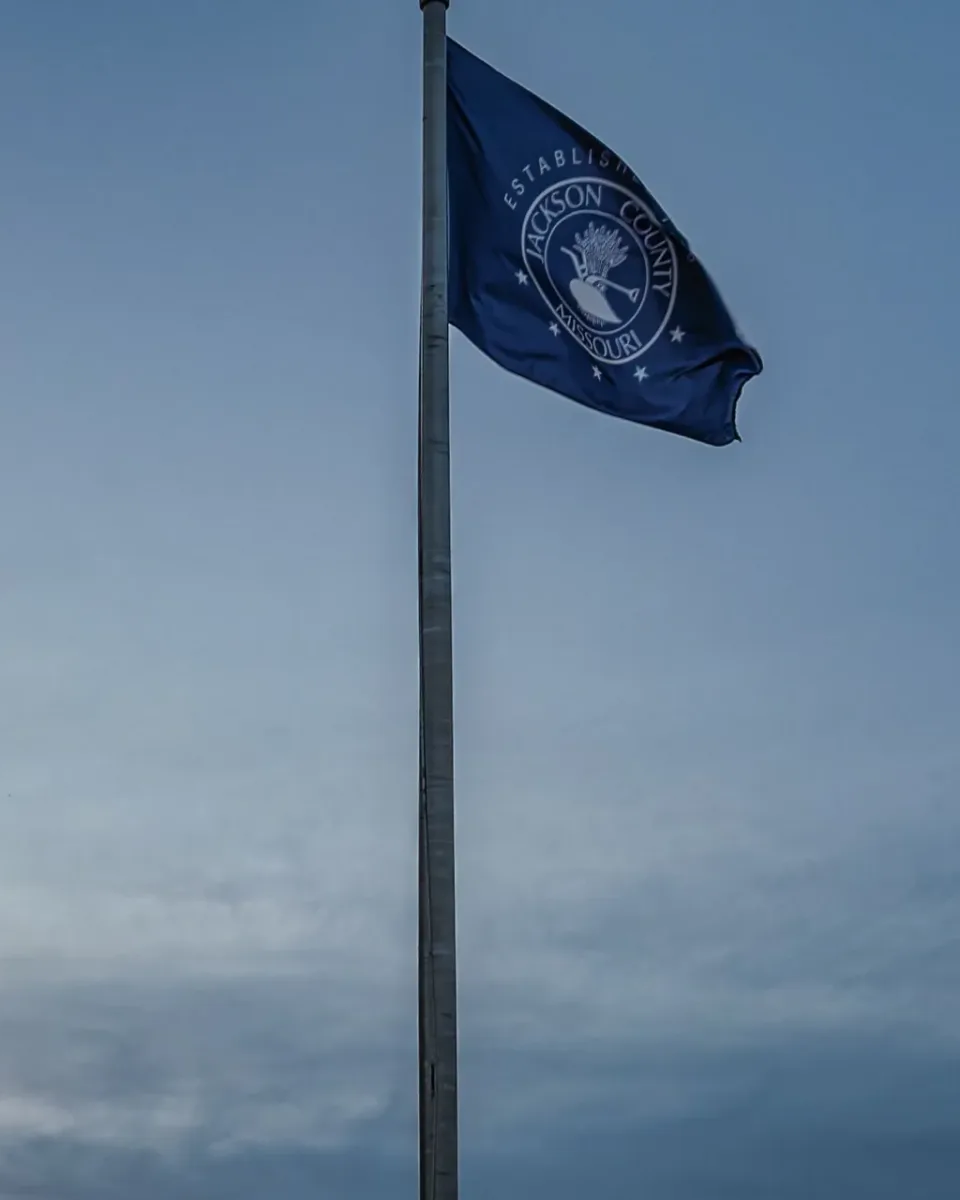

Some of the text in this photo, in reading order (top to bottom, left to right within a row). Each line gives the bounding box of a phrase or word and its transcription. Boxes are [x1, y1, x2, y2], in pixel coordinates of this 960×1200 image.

[527, 184, 673, 298] JACKSON COUNTY
[555, 303, 643, 360] MISSOURI
